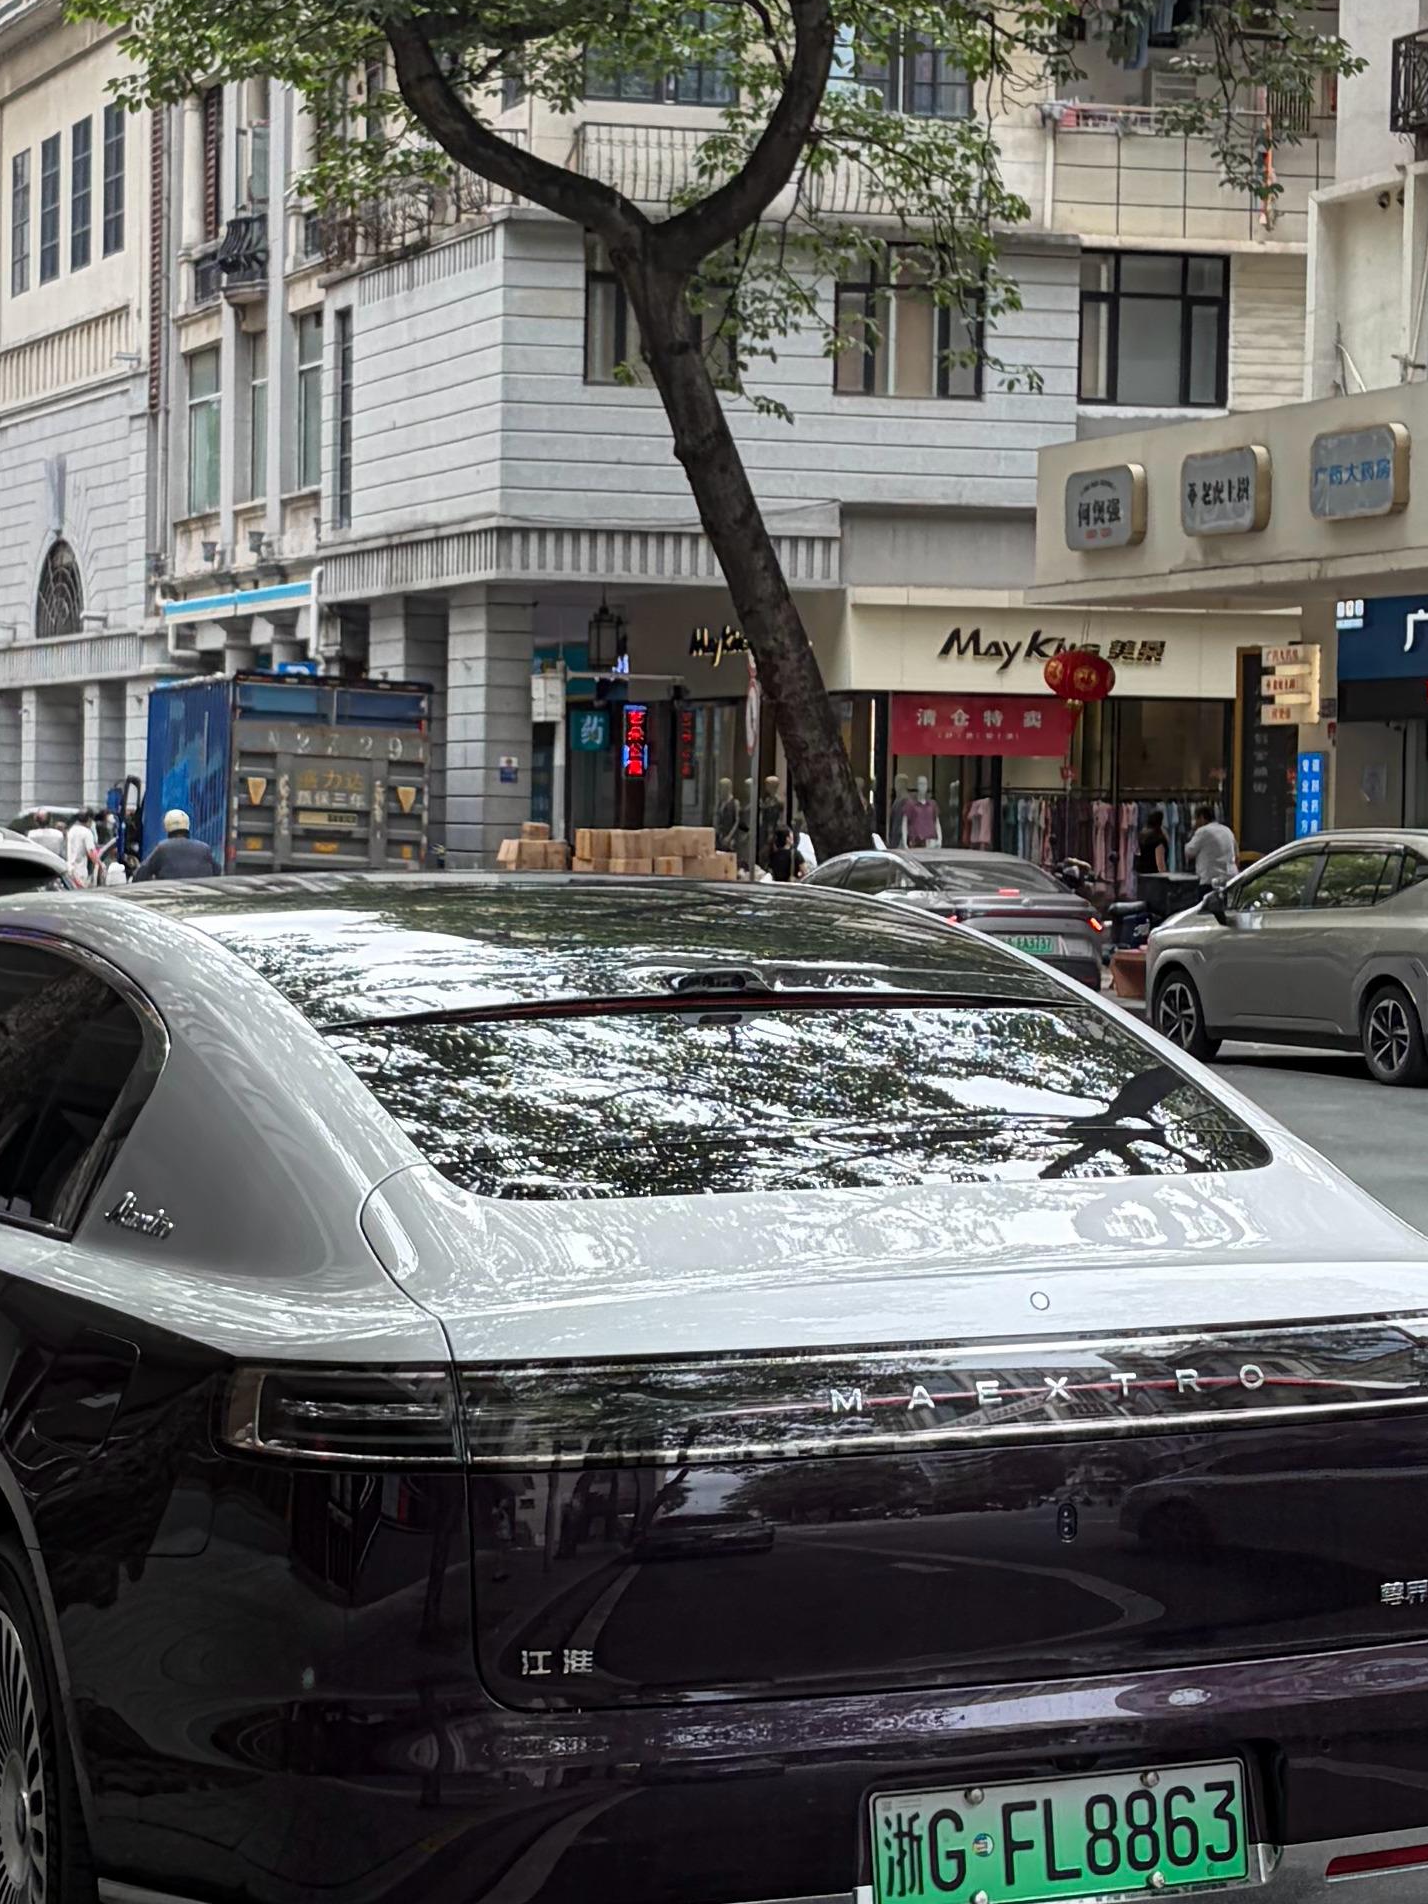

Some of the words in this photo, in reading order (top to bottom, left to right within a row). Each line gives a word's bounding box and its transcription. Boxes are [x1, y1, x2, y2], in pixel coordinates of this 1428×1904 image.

[580, 714, 605, 745] 药
[916, 708, 1042, 729] 清仓特卖
[830, 1363, 1266, 1414] MAEXTRO
[521, 1649, 594, 1676] 江淮
